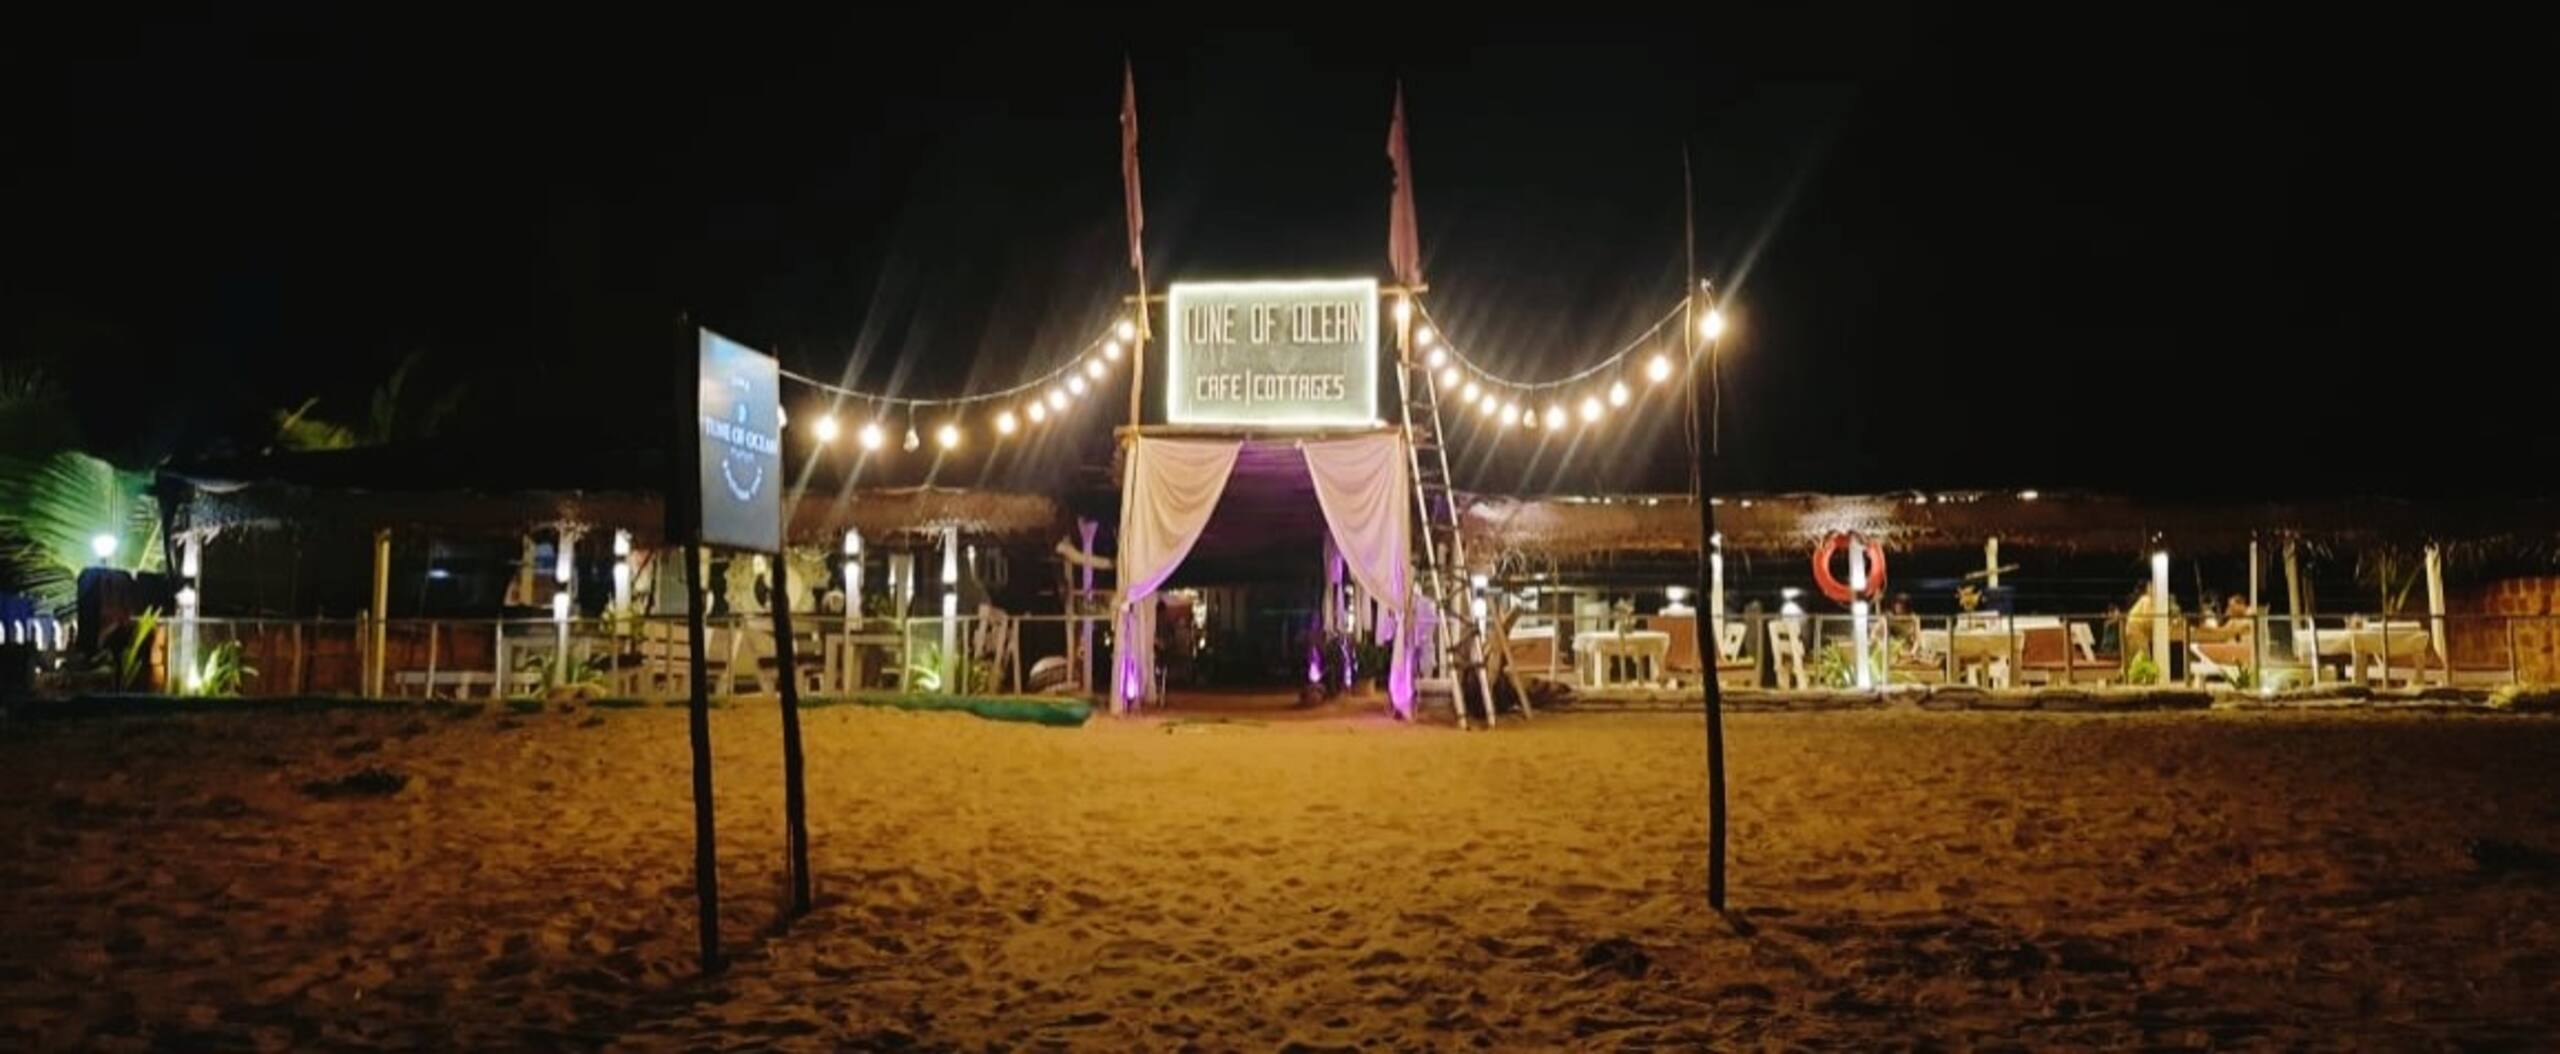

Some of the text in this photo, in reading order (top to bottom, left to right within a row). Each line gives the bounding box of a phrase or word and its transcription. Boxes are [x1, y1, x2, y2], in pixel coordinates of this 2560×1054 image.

[1181, 302, 1364, 344] TUNE OF OCEAN
[1197, 373, 1345, 401] CAFE COTTAGES
